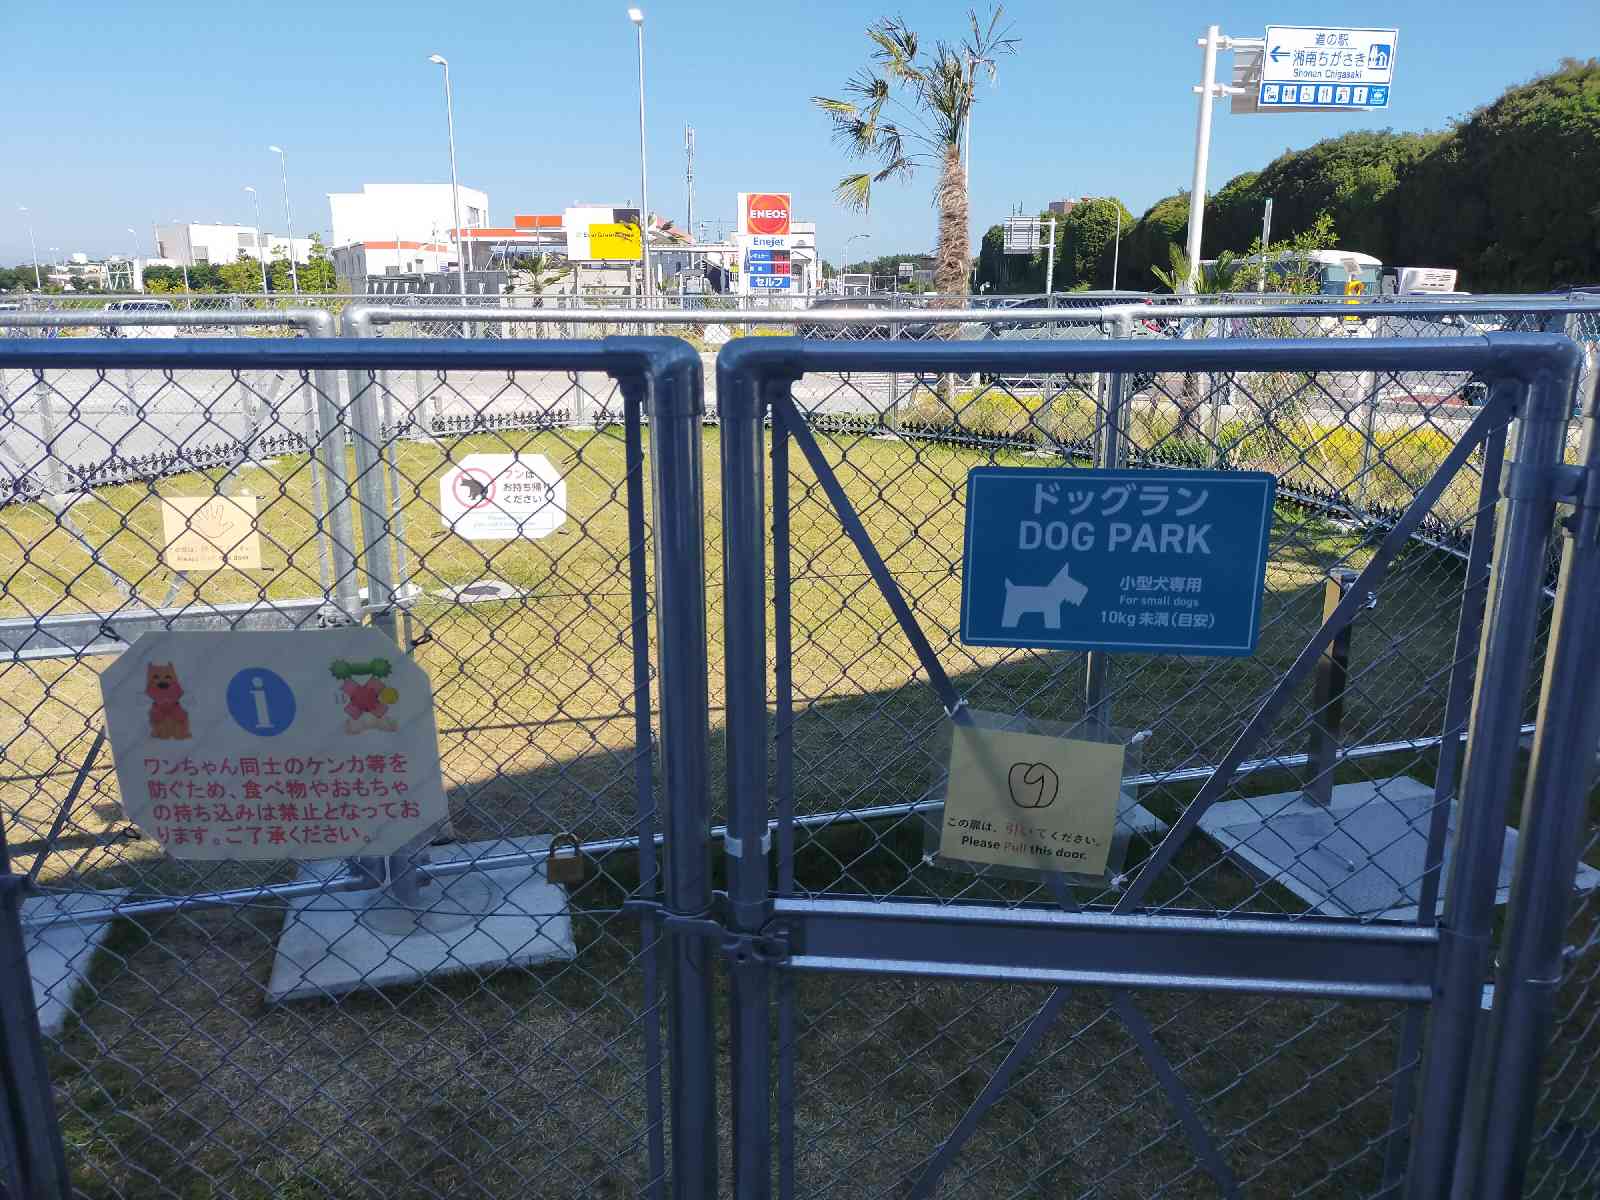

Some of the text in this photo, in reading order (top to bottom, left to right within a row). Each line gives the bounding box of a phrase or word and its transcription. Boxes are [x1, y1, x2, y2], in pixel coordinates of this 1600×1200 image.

[1315, 33, 1349, 46] 道の駅
[1292, 50, 1366, 67] 湘南ちがさき
[1293, 68, 1362, 80] Shonan Chigasaki
[750, 209, 788, 219] ENEOS
[753, 236, 785, 247] Enejet
[755, 277, 784, 287] セルフ
[503, 494, 542, 504] ください
[1033, 481, 1209, 516] ドッグラン
[1018, 519, 1214, 554] DOG PARK
[1119, 575, 1202, 593] 小型犬専用
[1120, 595, 1200, 609] For small dogs
[143, 753, 408, 777] ワンちゃん同士のケンカ等を
[147, 777, 409, 801] 防ぐため、食べ物やおもちゃ
[153, 800, 421, 823] の持ち込みは禁止となってお
[157, 824, 371, 845] ります。ご了承ください。
[961, 835, 1088, 861] Please Pull this door.
